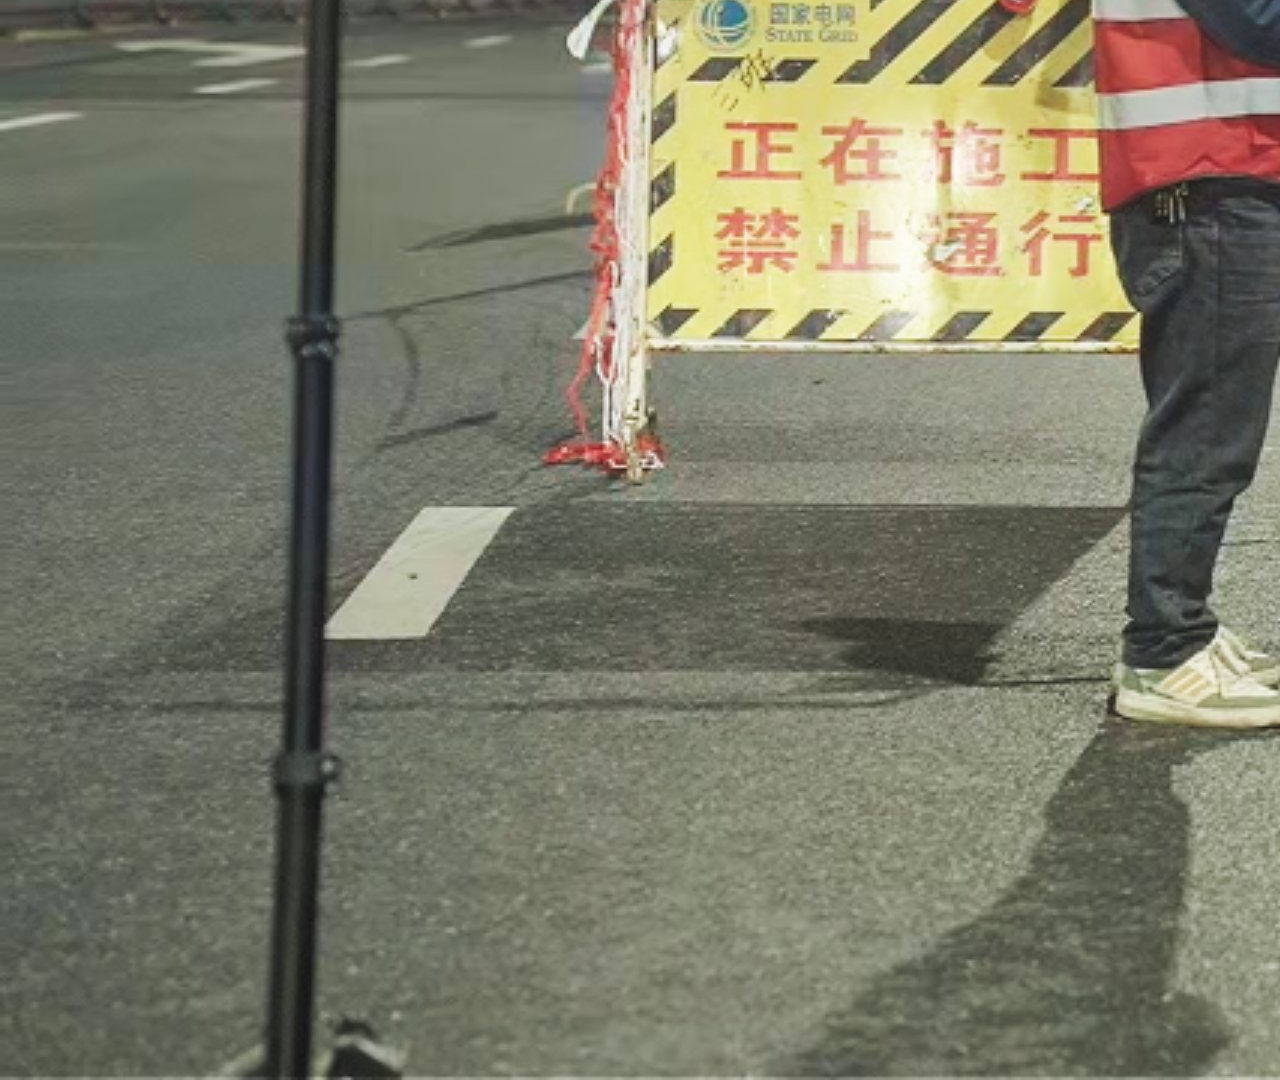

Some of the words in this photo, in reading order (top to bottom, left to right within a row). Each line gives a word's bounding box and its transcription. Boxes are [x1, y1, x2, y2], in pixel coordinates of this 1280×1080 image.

[765, 28, 814, 43] STATE
[818, 28, 859, 43] GRID
[769, 2, 856, 26] 国家电网
[716, 116, 1100, 187] 正在施工
[716, 209, 1101, 278] 禁止通行
